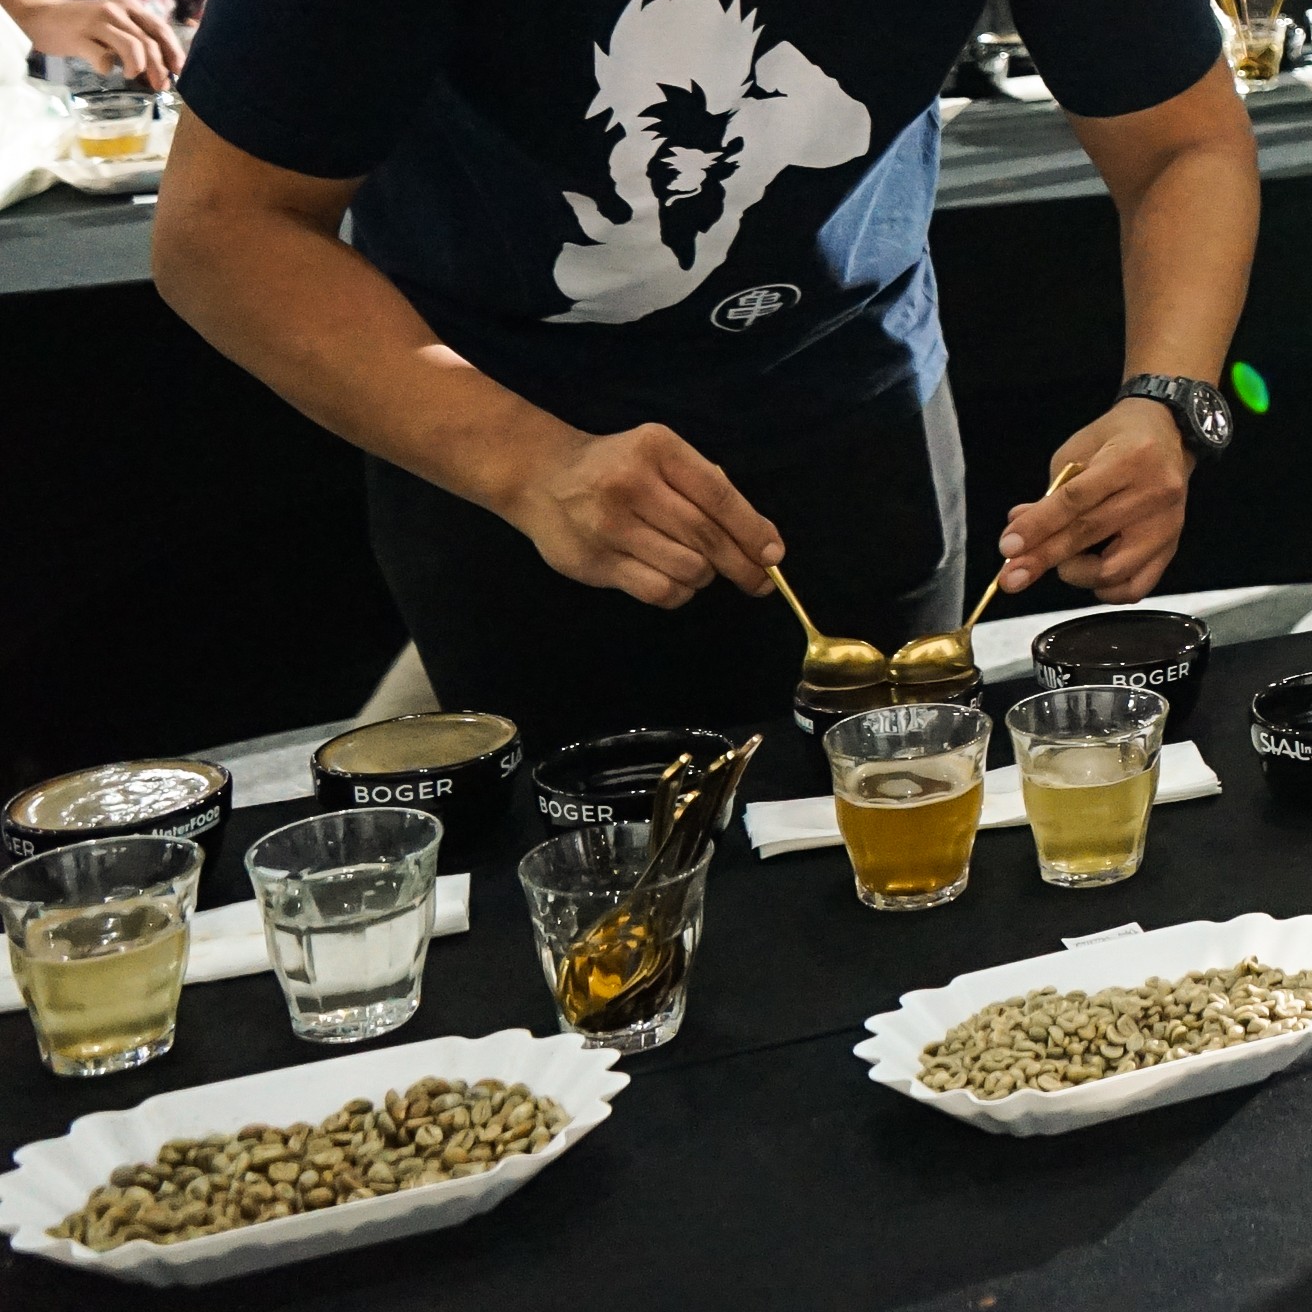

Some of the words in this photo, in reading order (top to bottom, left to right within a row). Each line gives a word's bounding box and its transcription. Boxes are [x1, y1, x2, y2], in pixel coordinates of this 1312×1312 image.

[1113, 662, 1190, 689] BOGER
[1259, 733, 1310, 761] SIAL
[354, 779, 453, 804] BOGER
[539, 795, 614, 823] BOGER
